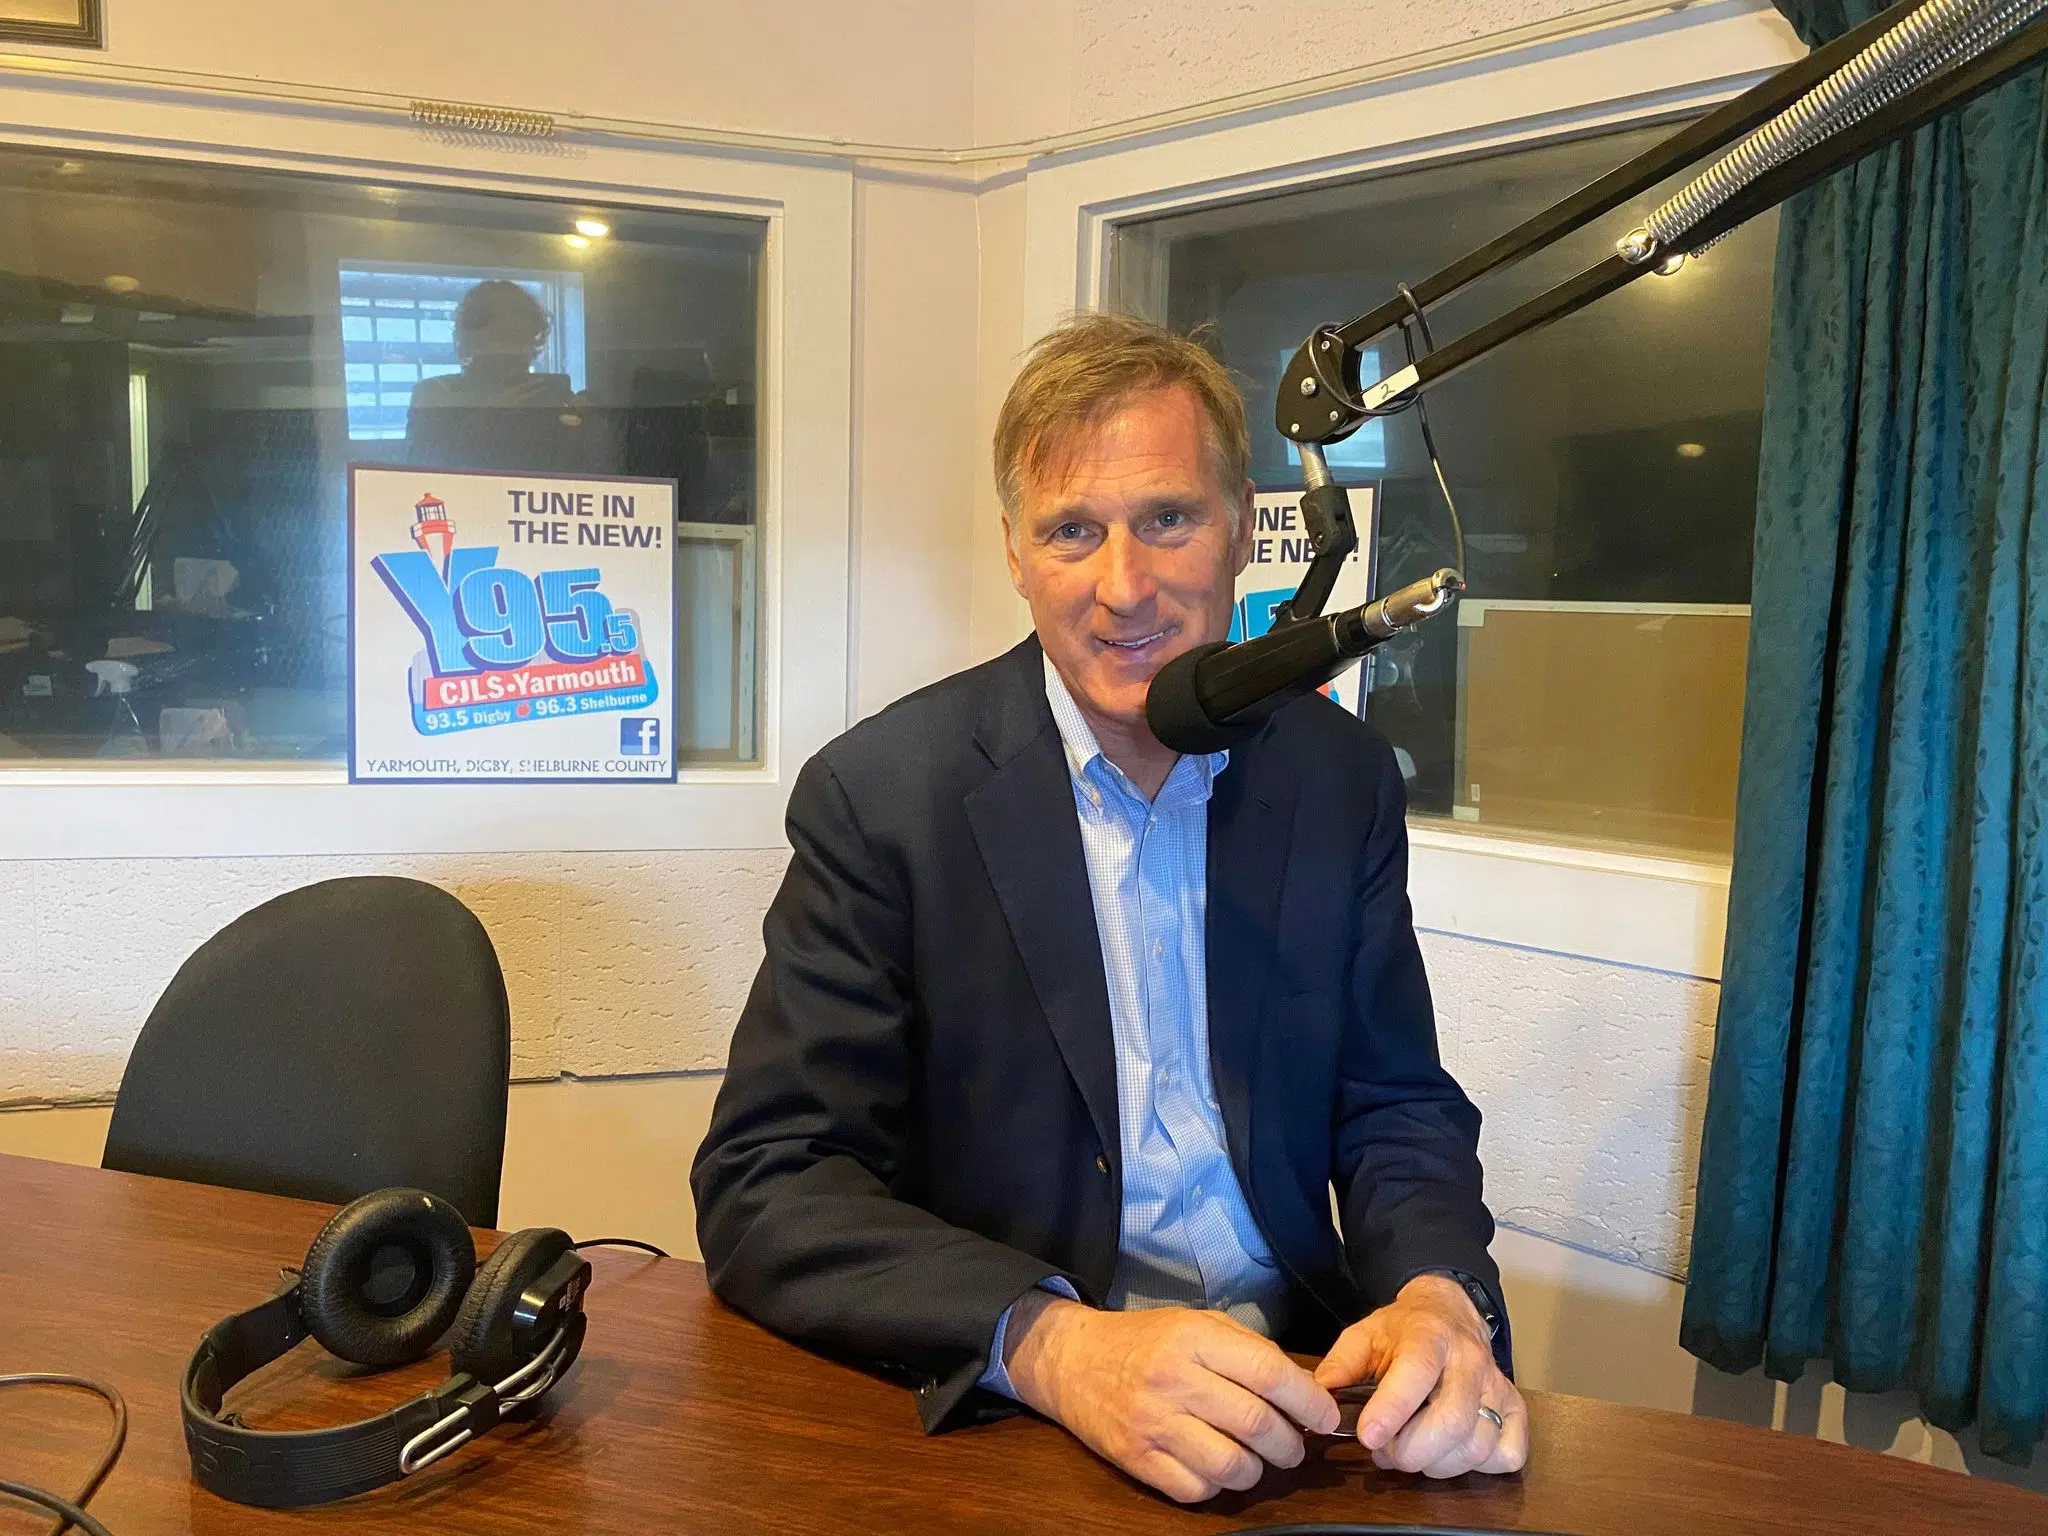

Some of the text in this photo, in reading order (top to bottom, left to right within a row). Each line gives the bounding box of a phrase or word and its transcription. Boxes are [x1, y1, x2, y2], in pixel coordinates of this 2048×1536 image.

[1380, 383, 1396, 400] 2
[507, 490, 635, 519] TUNE IN
[507, 520, 662, 549] THE NEW!
[425, 692, 648, 731] 93.5 Digby 96.3 Shelburne
[366, 759, 461, 774] YARMOUTH,
[604, 759, 667, 773] COUNTY
